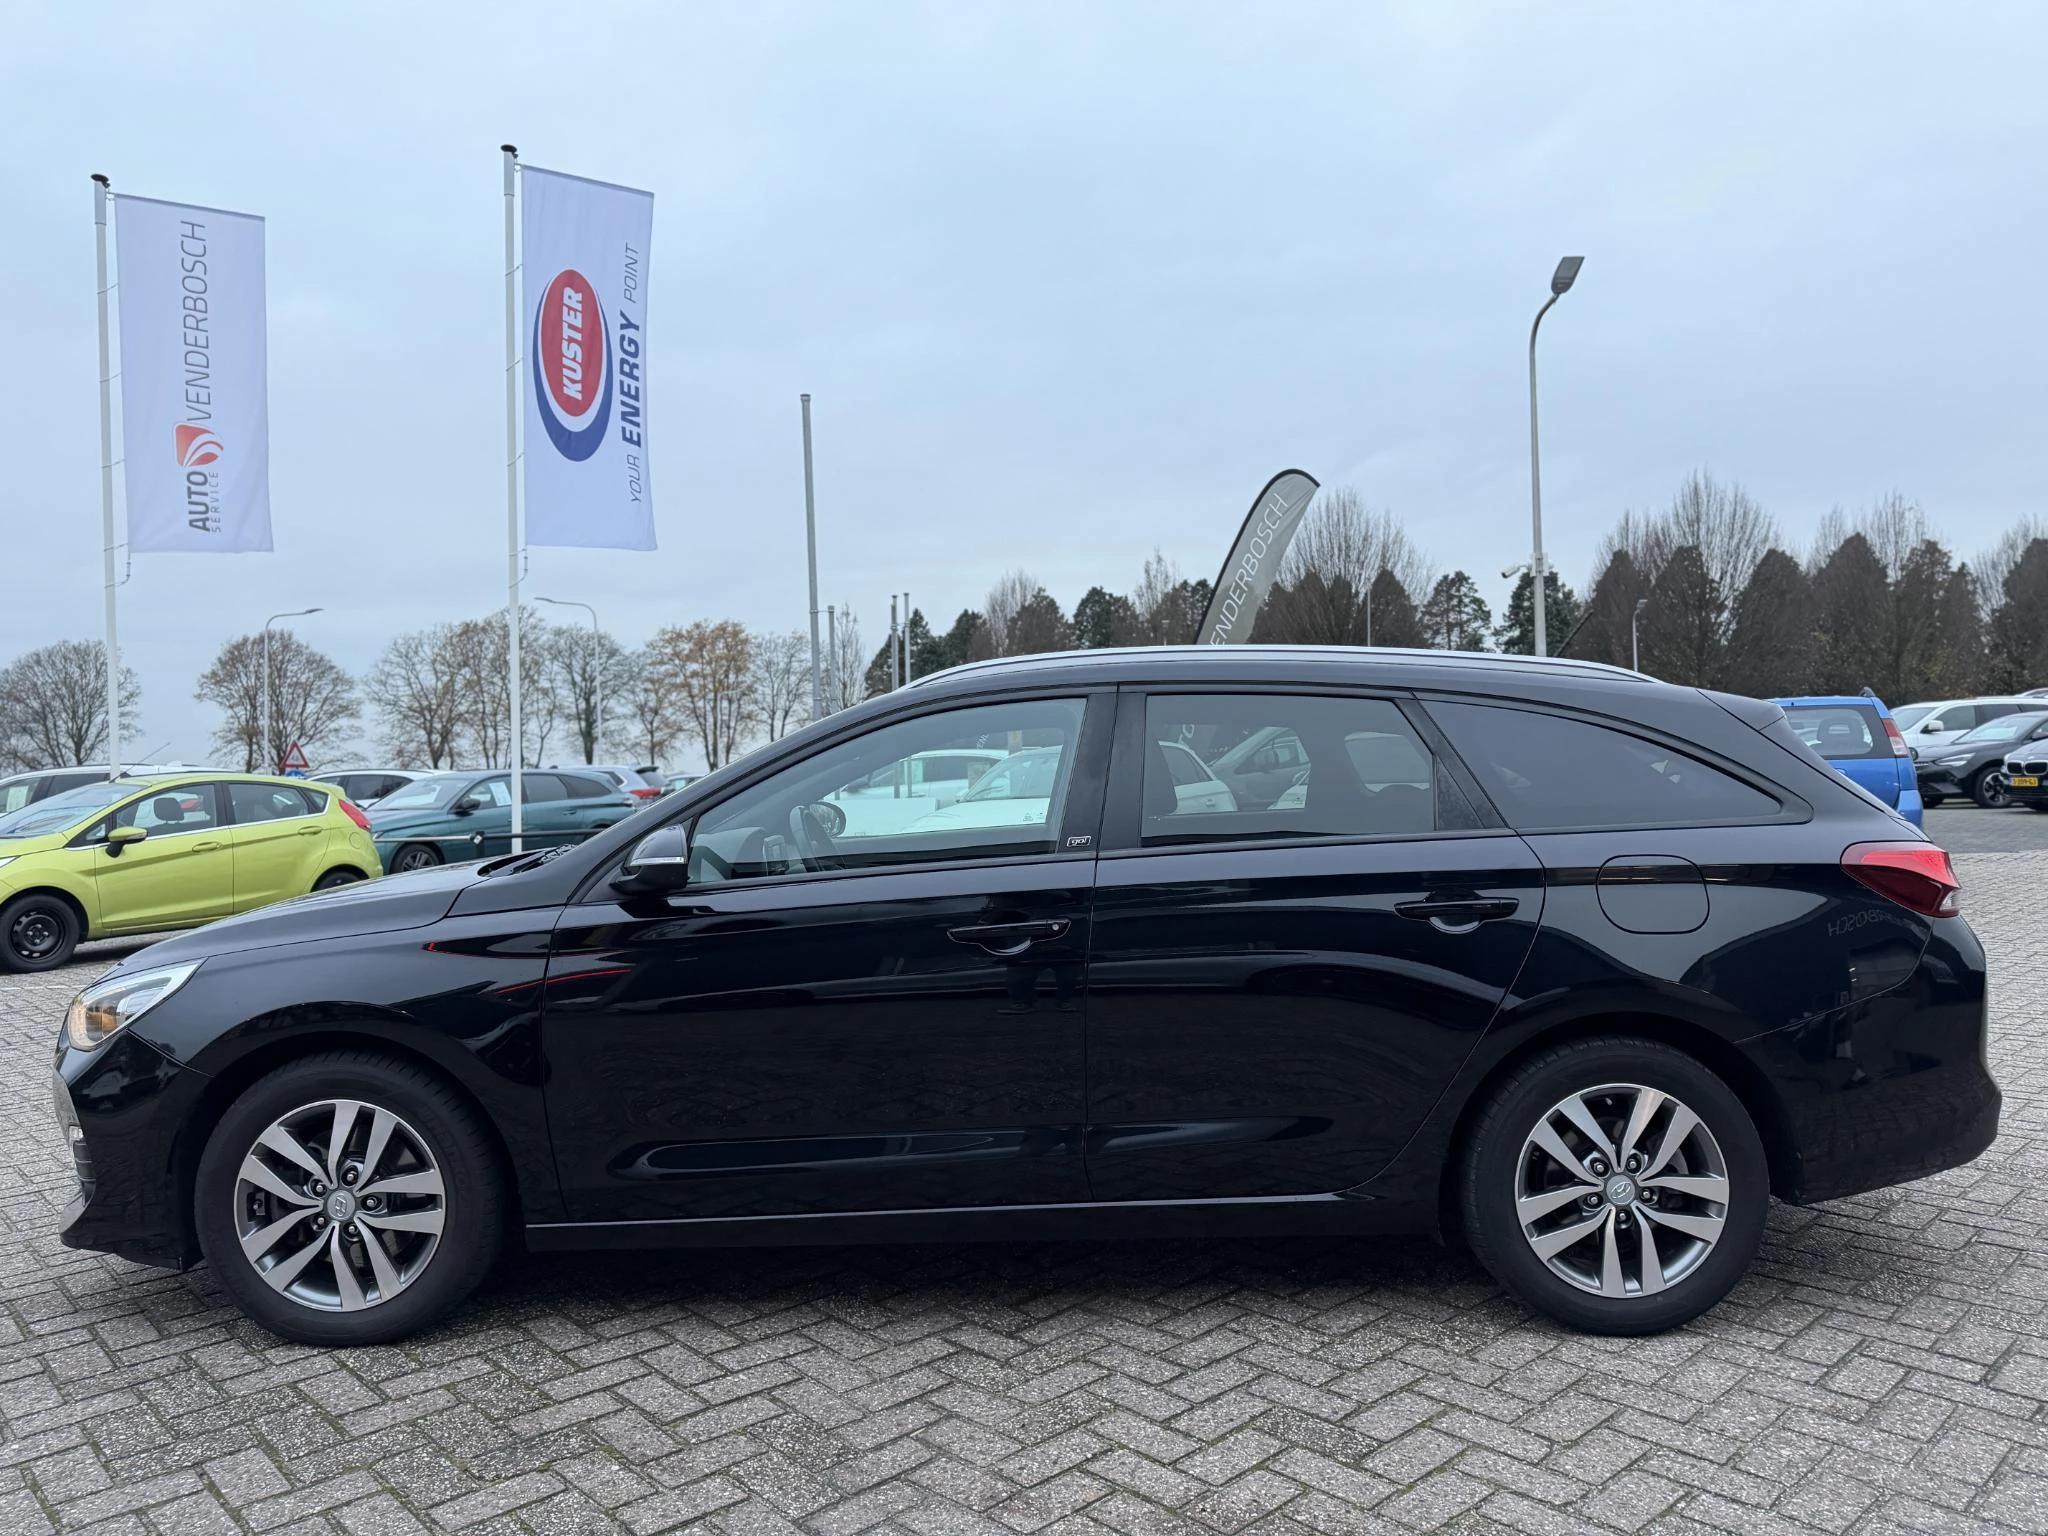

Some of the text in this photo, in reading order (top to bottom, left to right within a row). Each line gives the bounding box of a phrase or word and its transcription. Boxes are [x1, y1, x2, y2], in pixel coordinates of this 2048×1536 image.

[180, 220, 212, 532] AUTO VENDERBOSCH
[561, 286, 583, 401] KUSTER
[619, 242, 642, 503] YOUR ENERGY POINT
[209, 471, 222, 533] SERVICE
[1210, 493, 1289, 646] ENDERBOSCH
